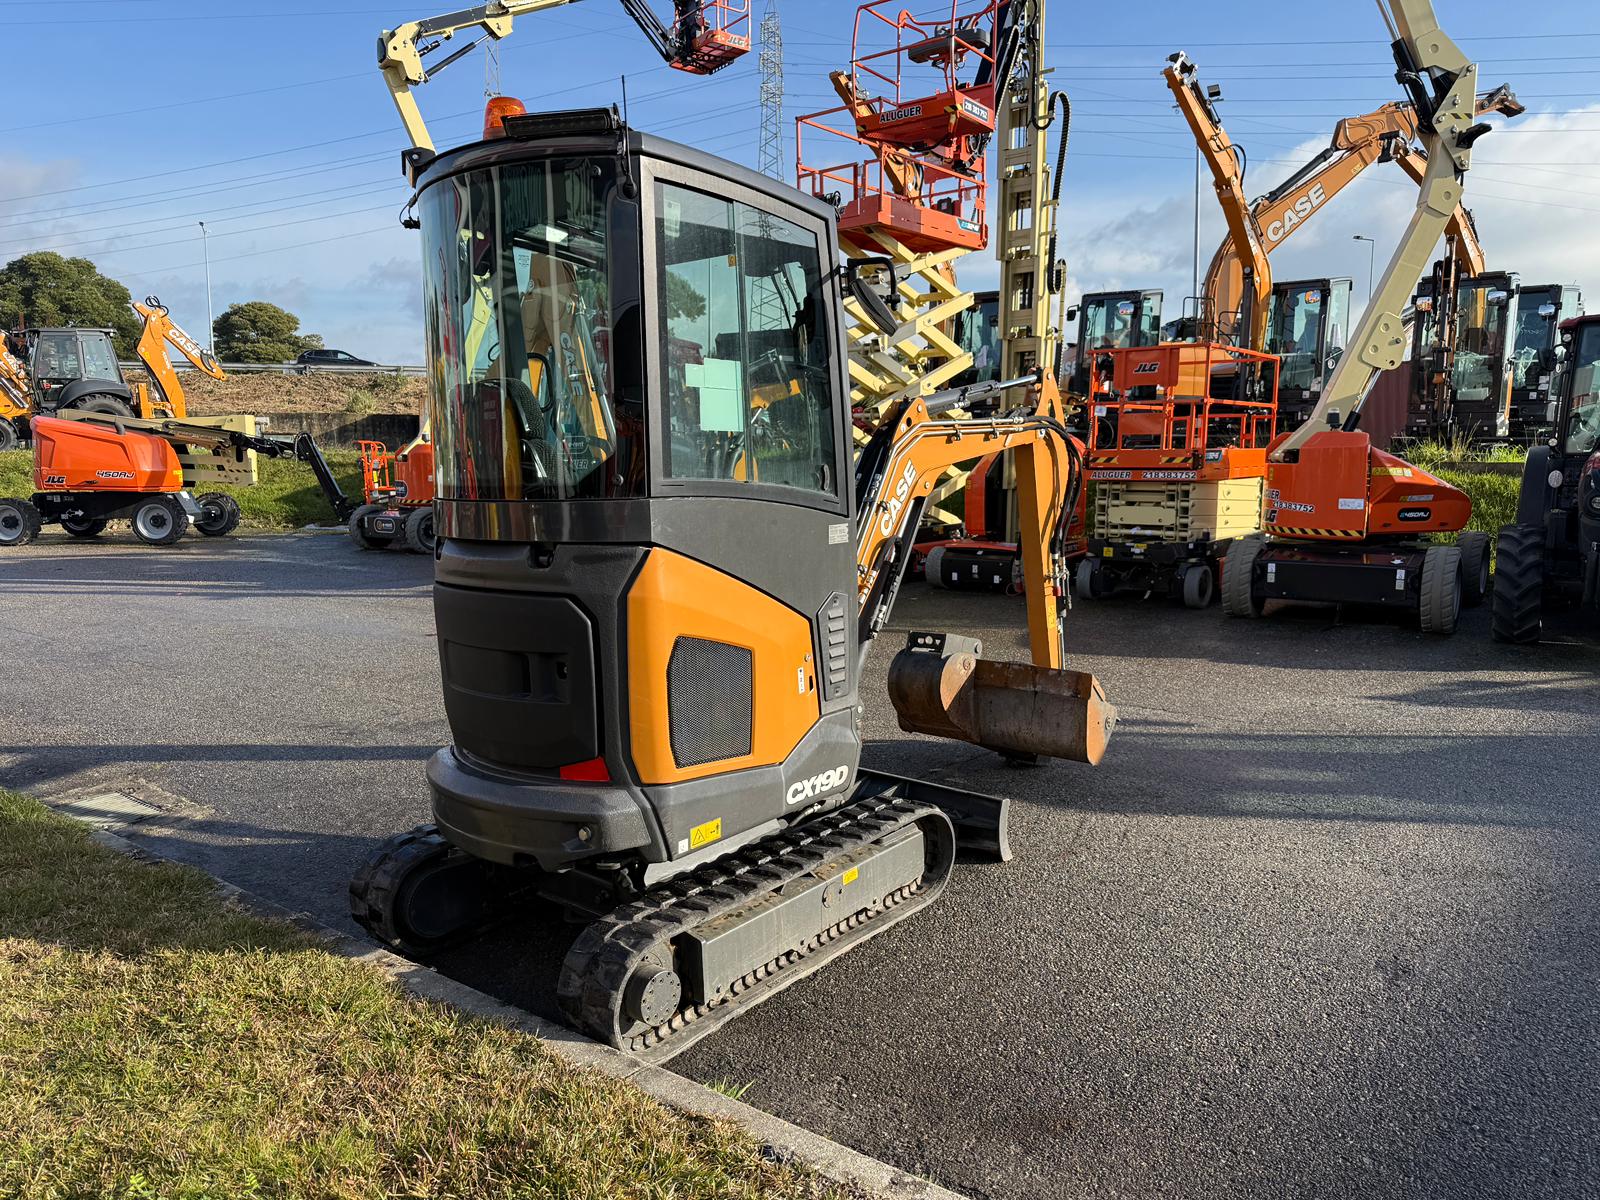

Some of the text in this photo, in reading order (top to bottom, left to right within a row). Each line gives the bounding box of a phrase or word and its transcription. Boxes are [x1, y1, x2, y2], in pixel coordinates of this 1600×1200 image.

[727, 35, 745, 46] JLG
[880, 105, 923, 123] ALUGUER
[1266, 181, 1327, 243] CASE
[168, 328, 203, 359] CASE
[1133, 361, 1160, 374] JLG
[44, 475, 66, 485] JLG
[95, 470, 136, 479] 450AJ
[1089, 469, 1198, 480] ALUGUER 218383752
[880, 457, 918, 537] CASE
[1264, 507, 1279, 523] LG
[786, 764, 849, 805] CX19D
